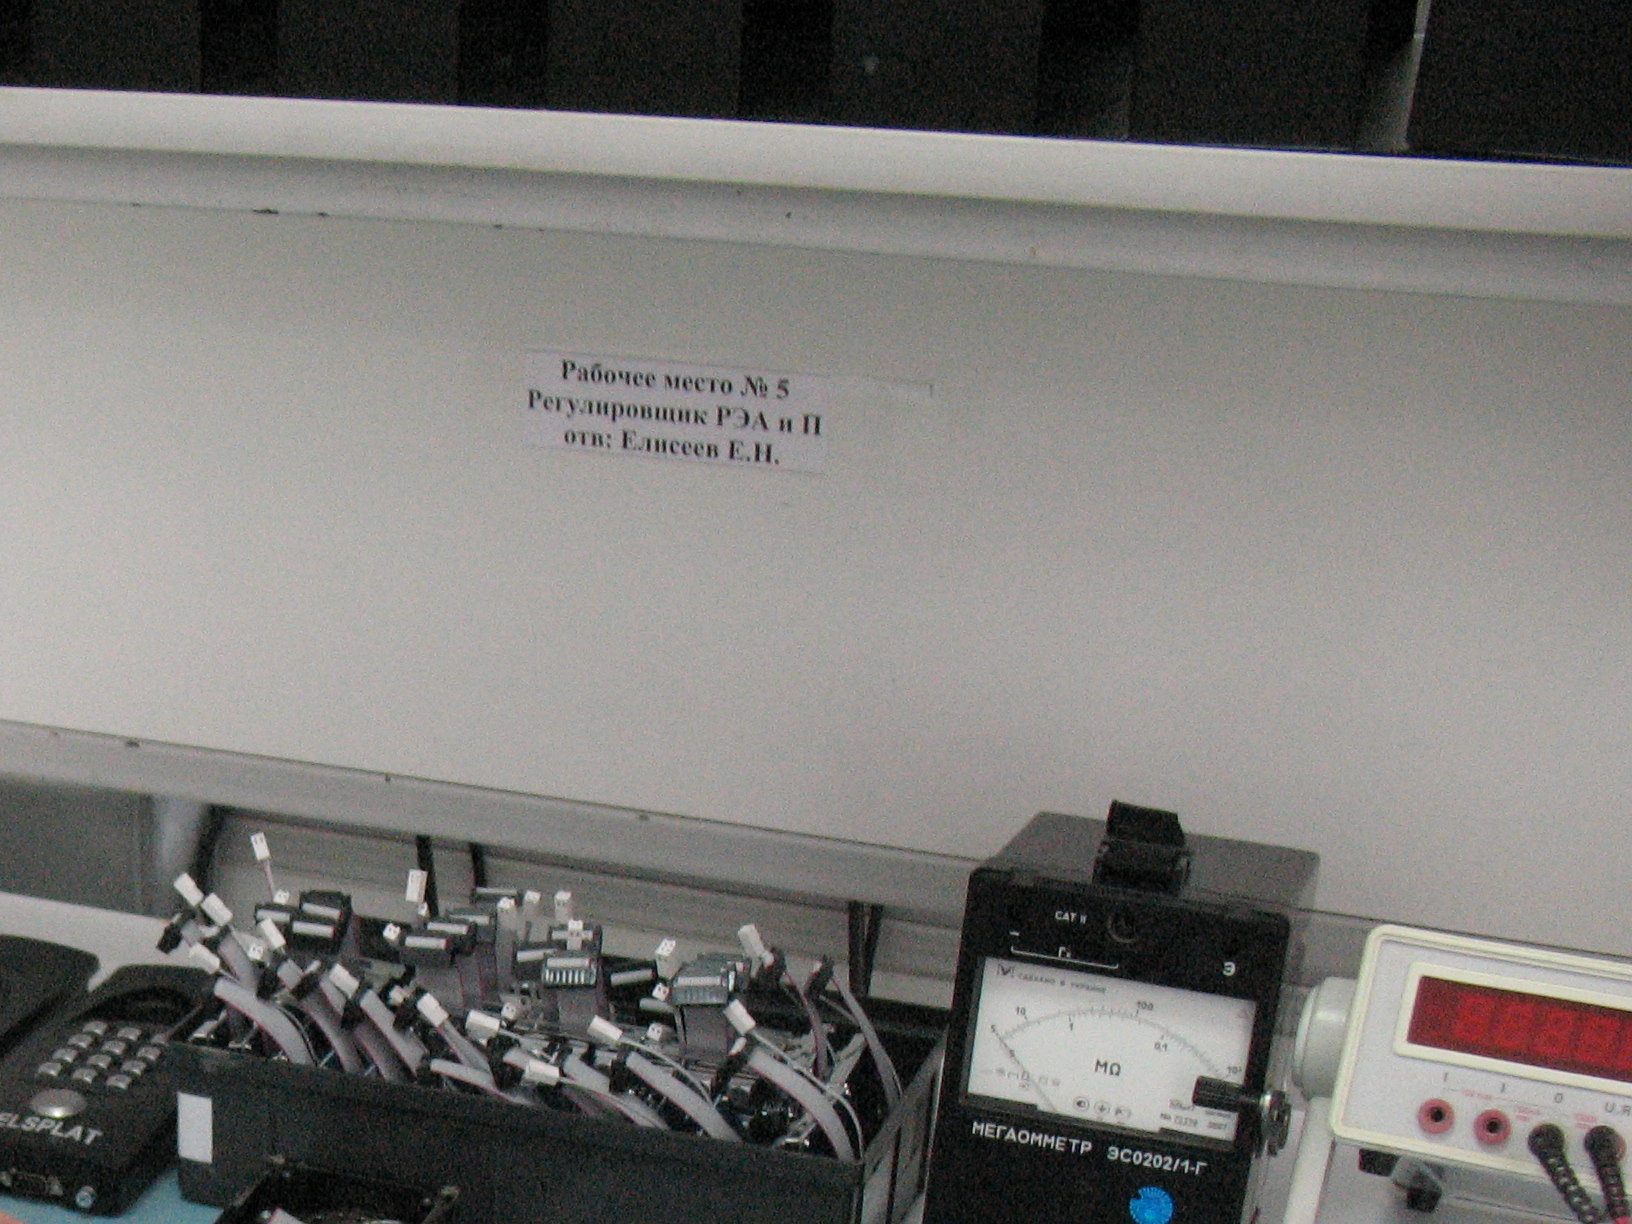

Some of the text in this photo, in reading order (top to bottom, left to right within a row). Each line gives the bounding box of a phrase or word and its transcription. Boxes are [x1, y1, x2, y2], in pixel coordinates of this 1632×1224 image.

[561, 359, 790, 399] Рабочее место № 5
[528, 388, 822, 435] Регулировщик РЭА и П
[564, 428, 780, 466] отв: Елисеев Е.Н.
[1054, 910, 1078, 923] CAT
[971, 1120, 1093, 1156] МЕГАОММЕТР
